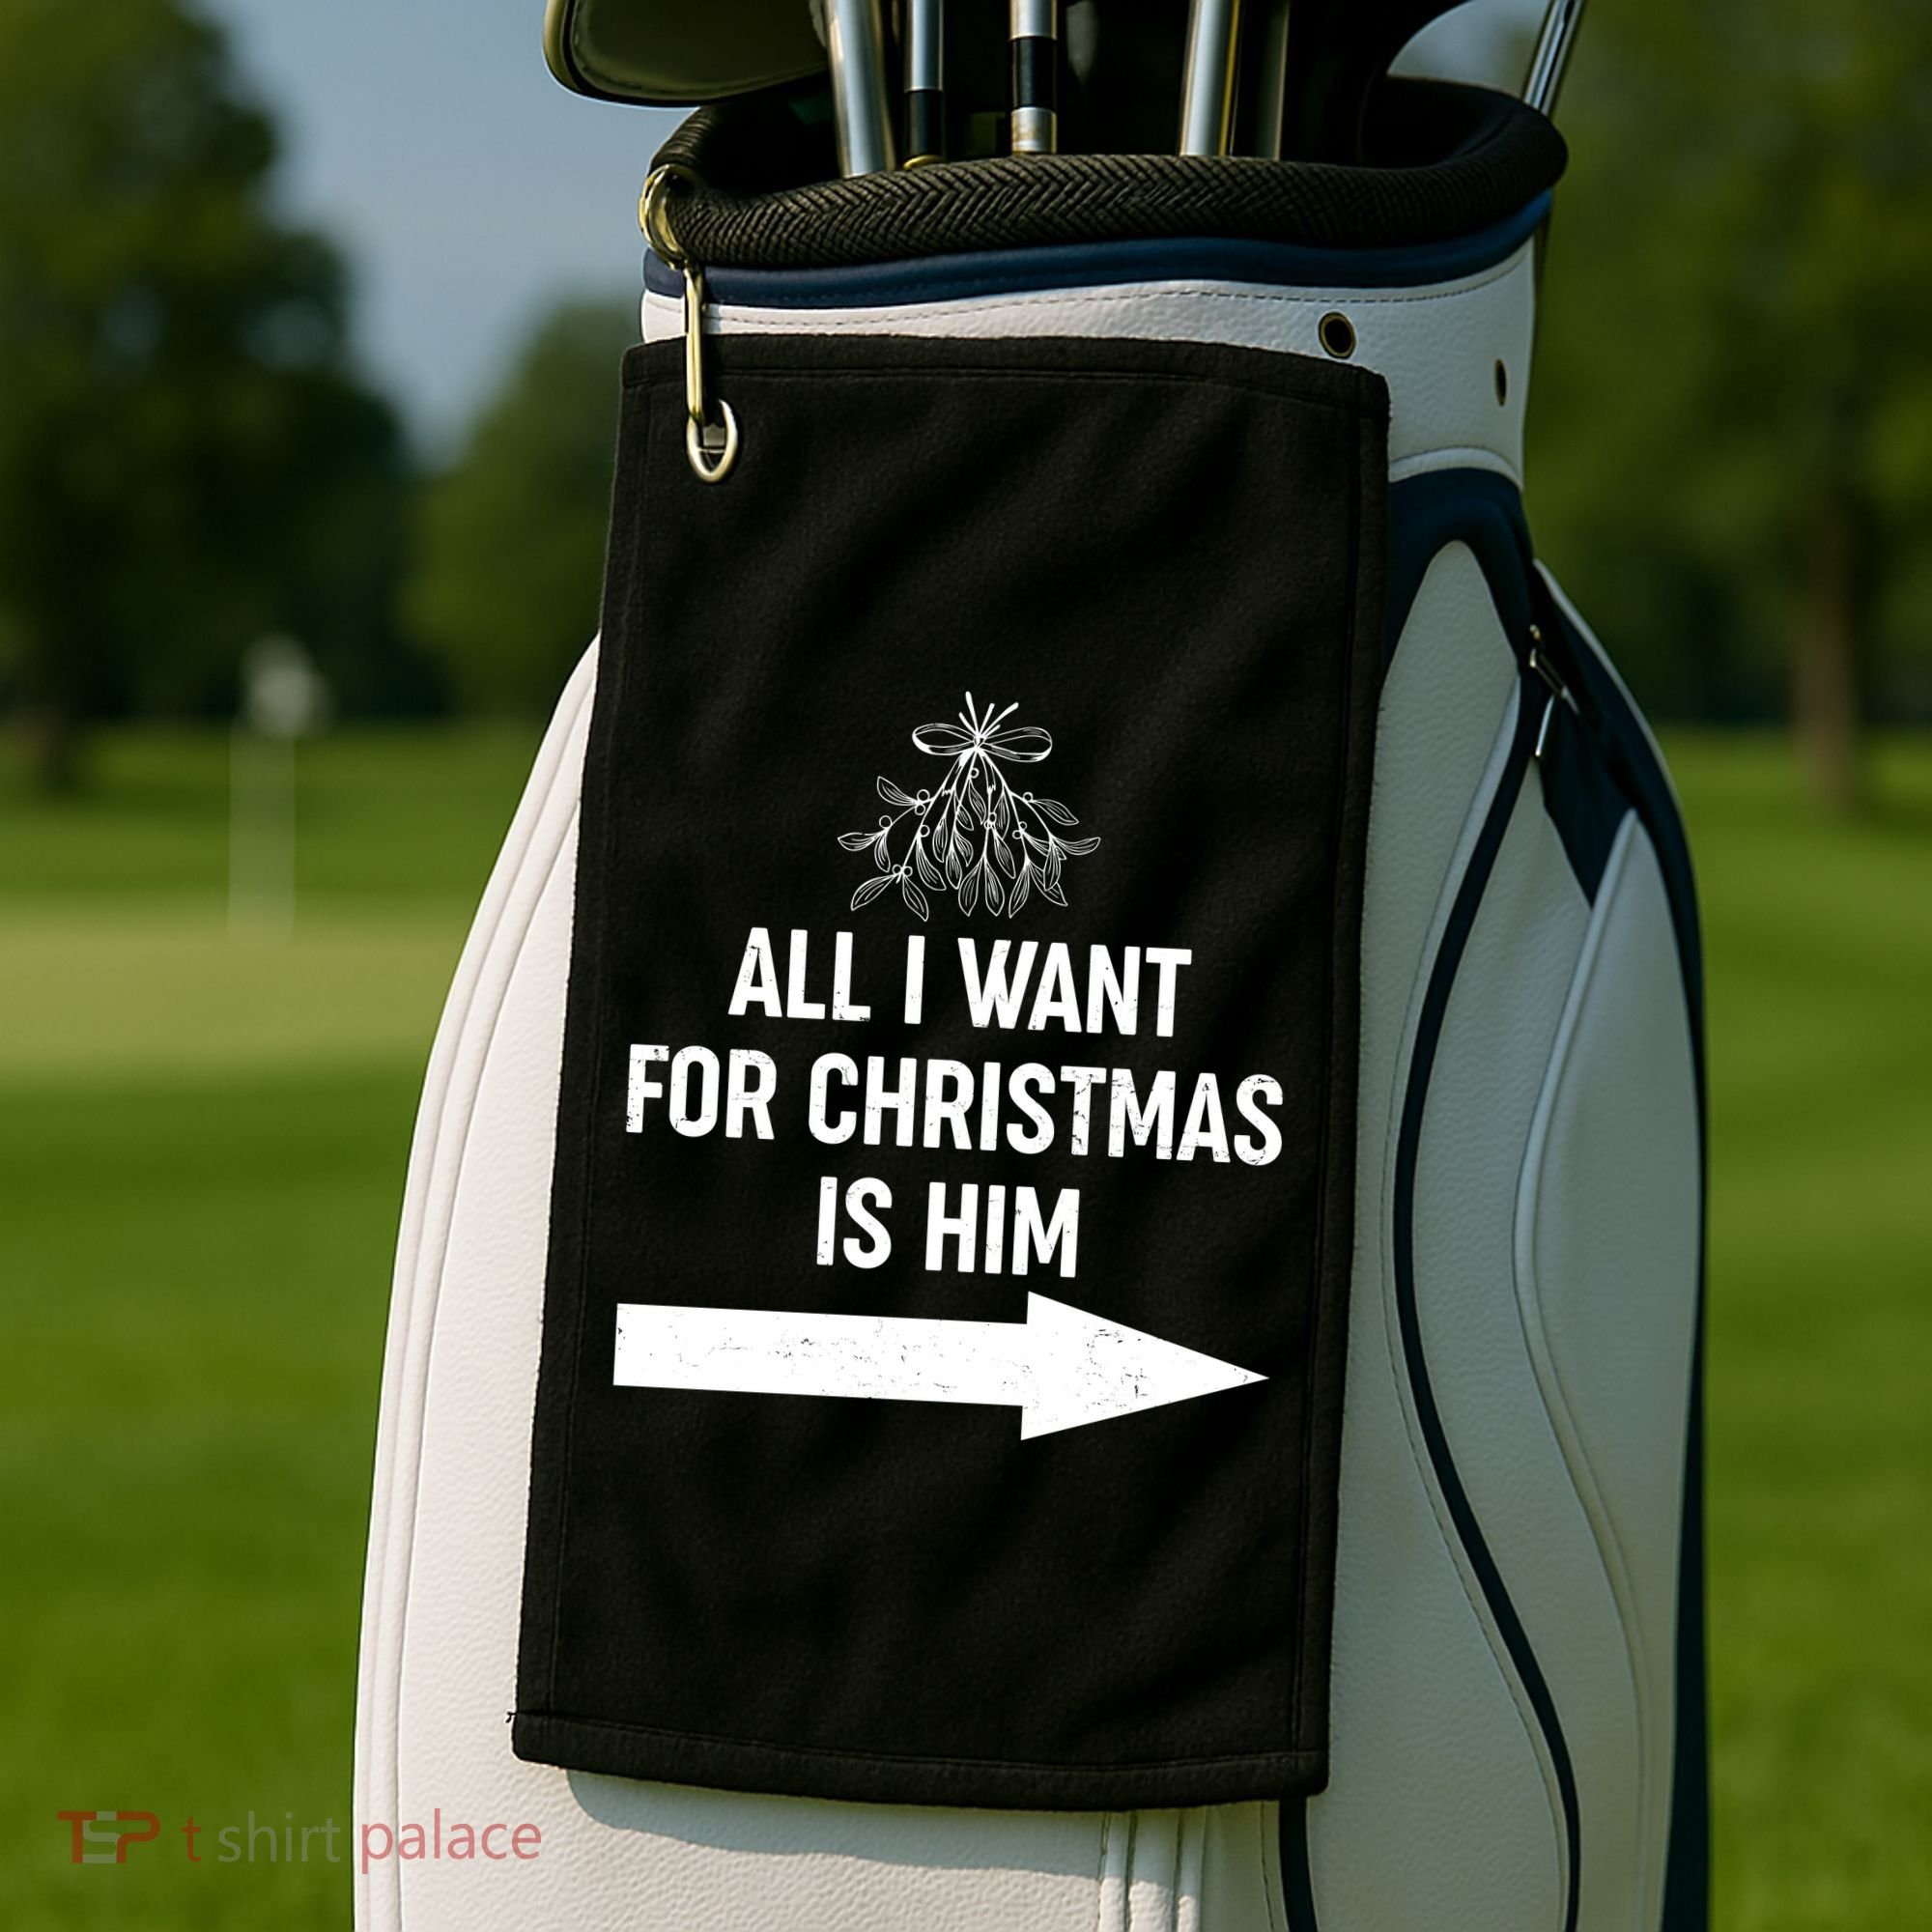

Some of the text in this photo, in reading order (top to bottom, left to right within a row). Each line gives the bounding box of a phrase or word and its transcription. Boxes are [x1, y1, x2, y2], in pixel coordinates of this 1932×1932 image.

[728, 926, 1193, 1037] ALL I WANT
[626, 1043, 1284, 1166] FOR CHRISTMAS
[816, 1176, 1081, 1278] IS HIM
